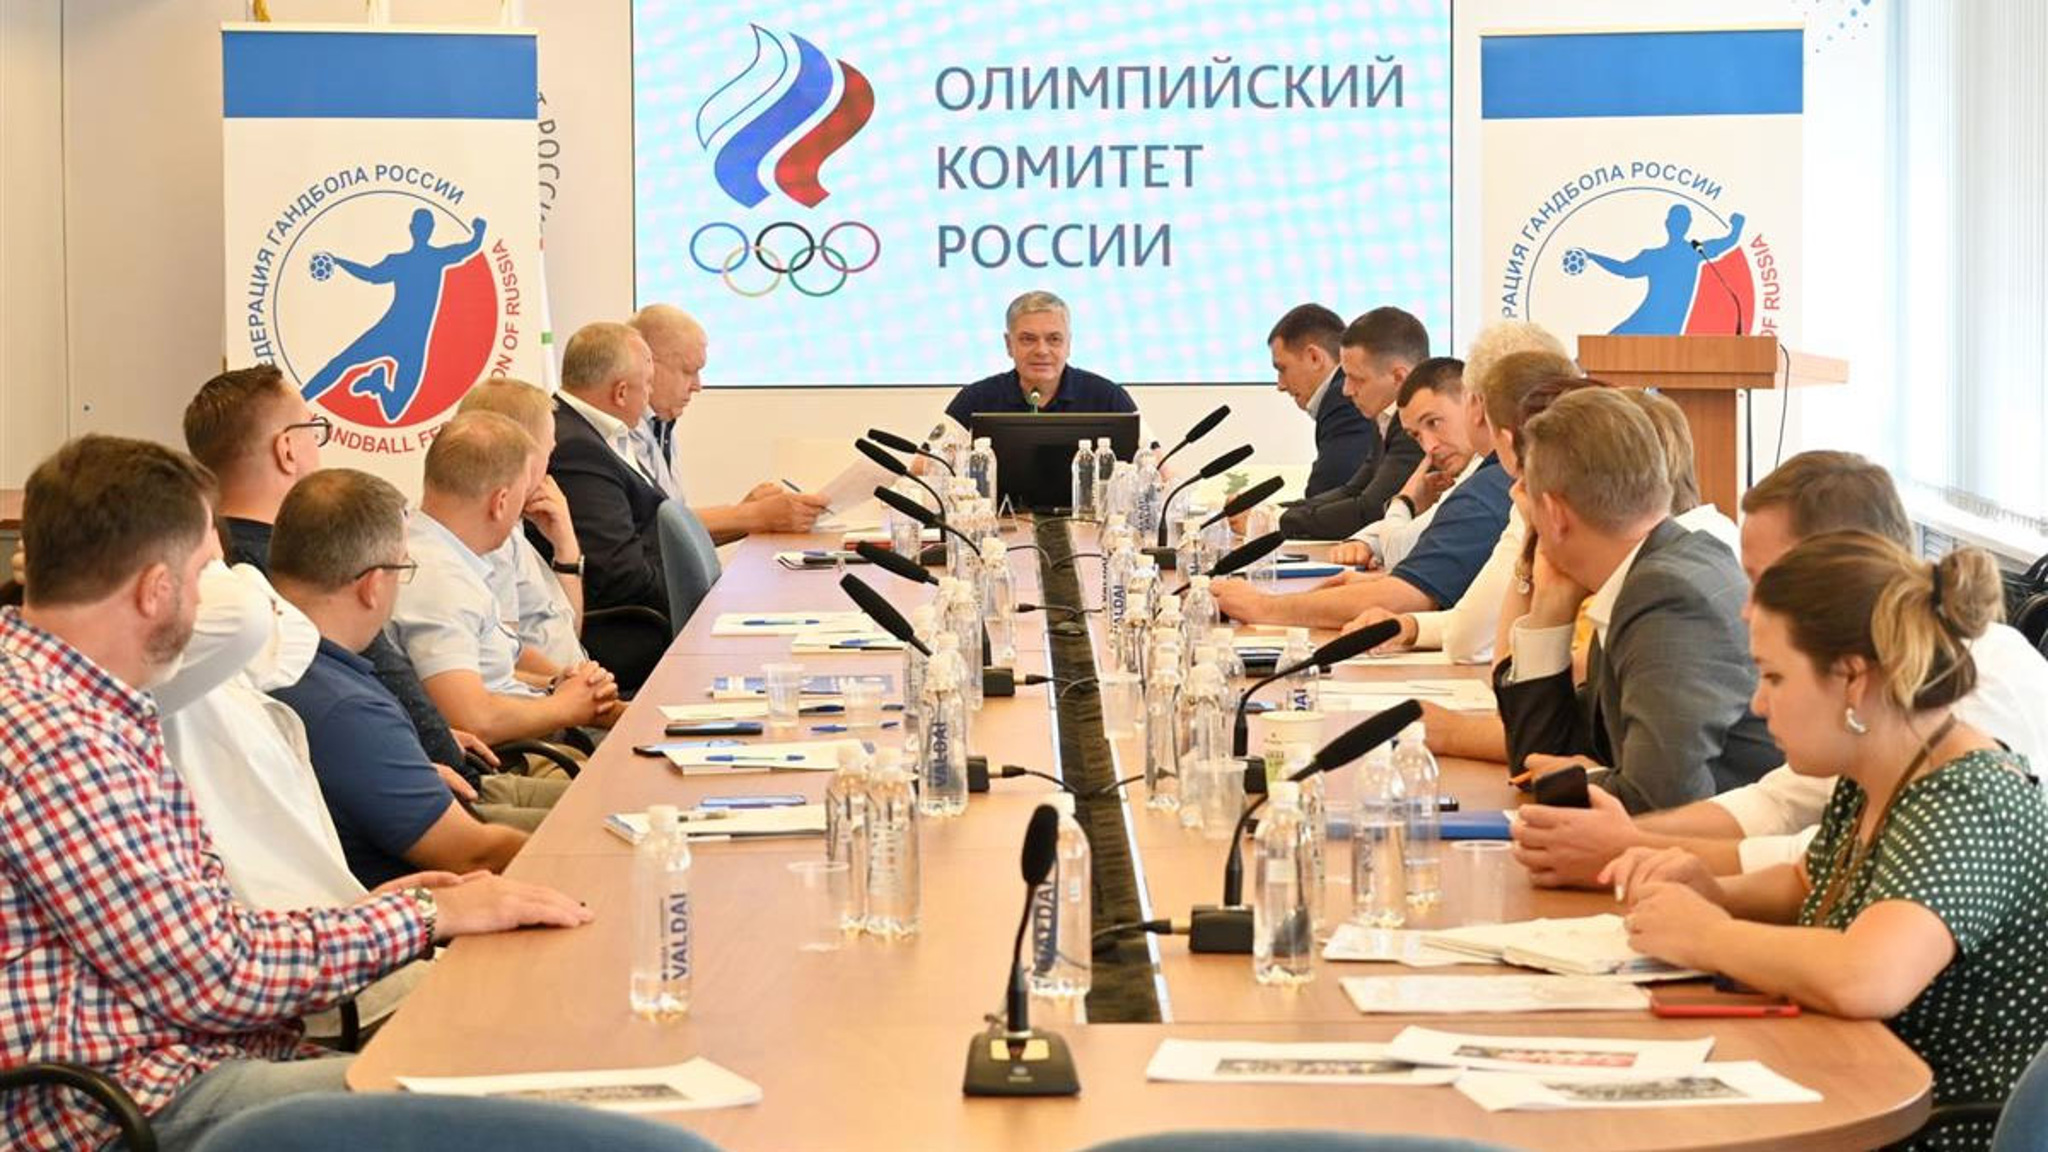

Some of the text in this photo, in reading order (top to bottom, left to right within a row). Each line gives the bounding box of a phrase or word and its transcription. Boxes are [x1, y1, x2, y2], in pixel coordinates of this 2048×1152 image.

[935, 55, 1404, 111] ОЛИМПИЙСКИЙ
[538, 119, 561, 222] РОСС
[937, 144, 1203, 190] КОМИТЕТ
[248, 165, 464, 365] ДЕРАЦИЯ ГАНДБОЛА РОССИИ
[937, 223, 1172, 269] РОССИИ
[1502, 162, 1723, 319] РАЦИЯ ГАНДБОЛА РОССИИ
[1750, 233, 1780, 310] RUSSIA
[328, 238, 520, 453] NDBALL OF RUSSIA
[669, 893, 687, 980] VALDAI
